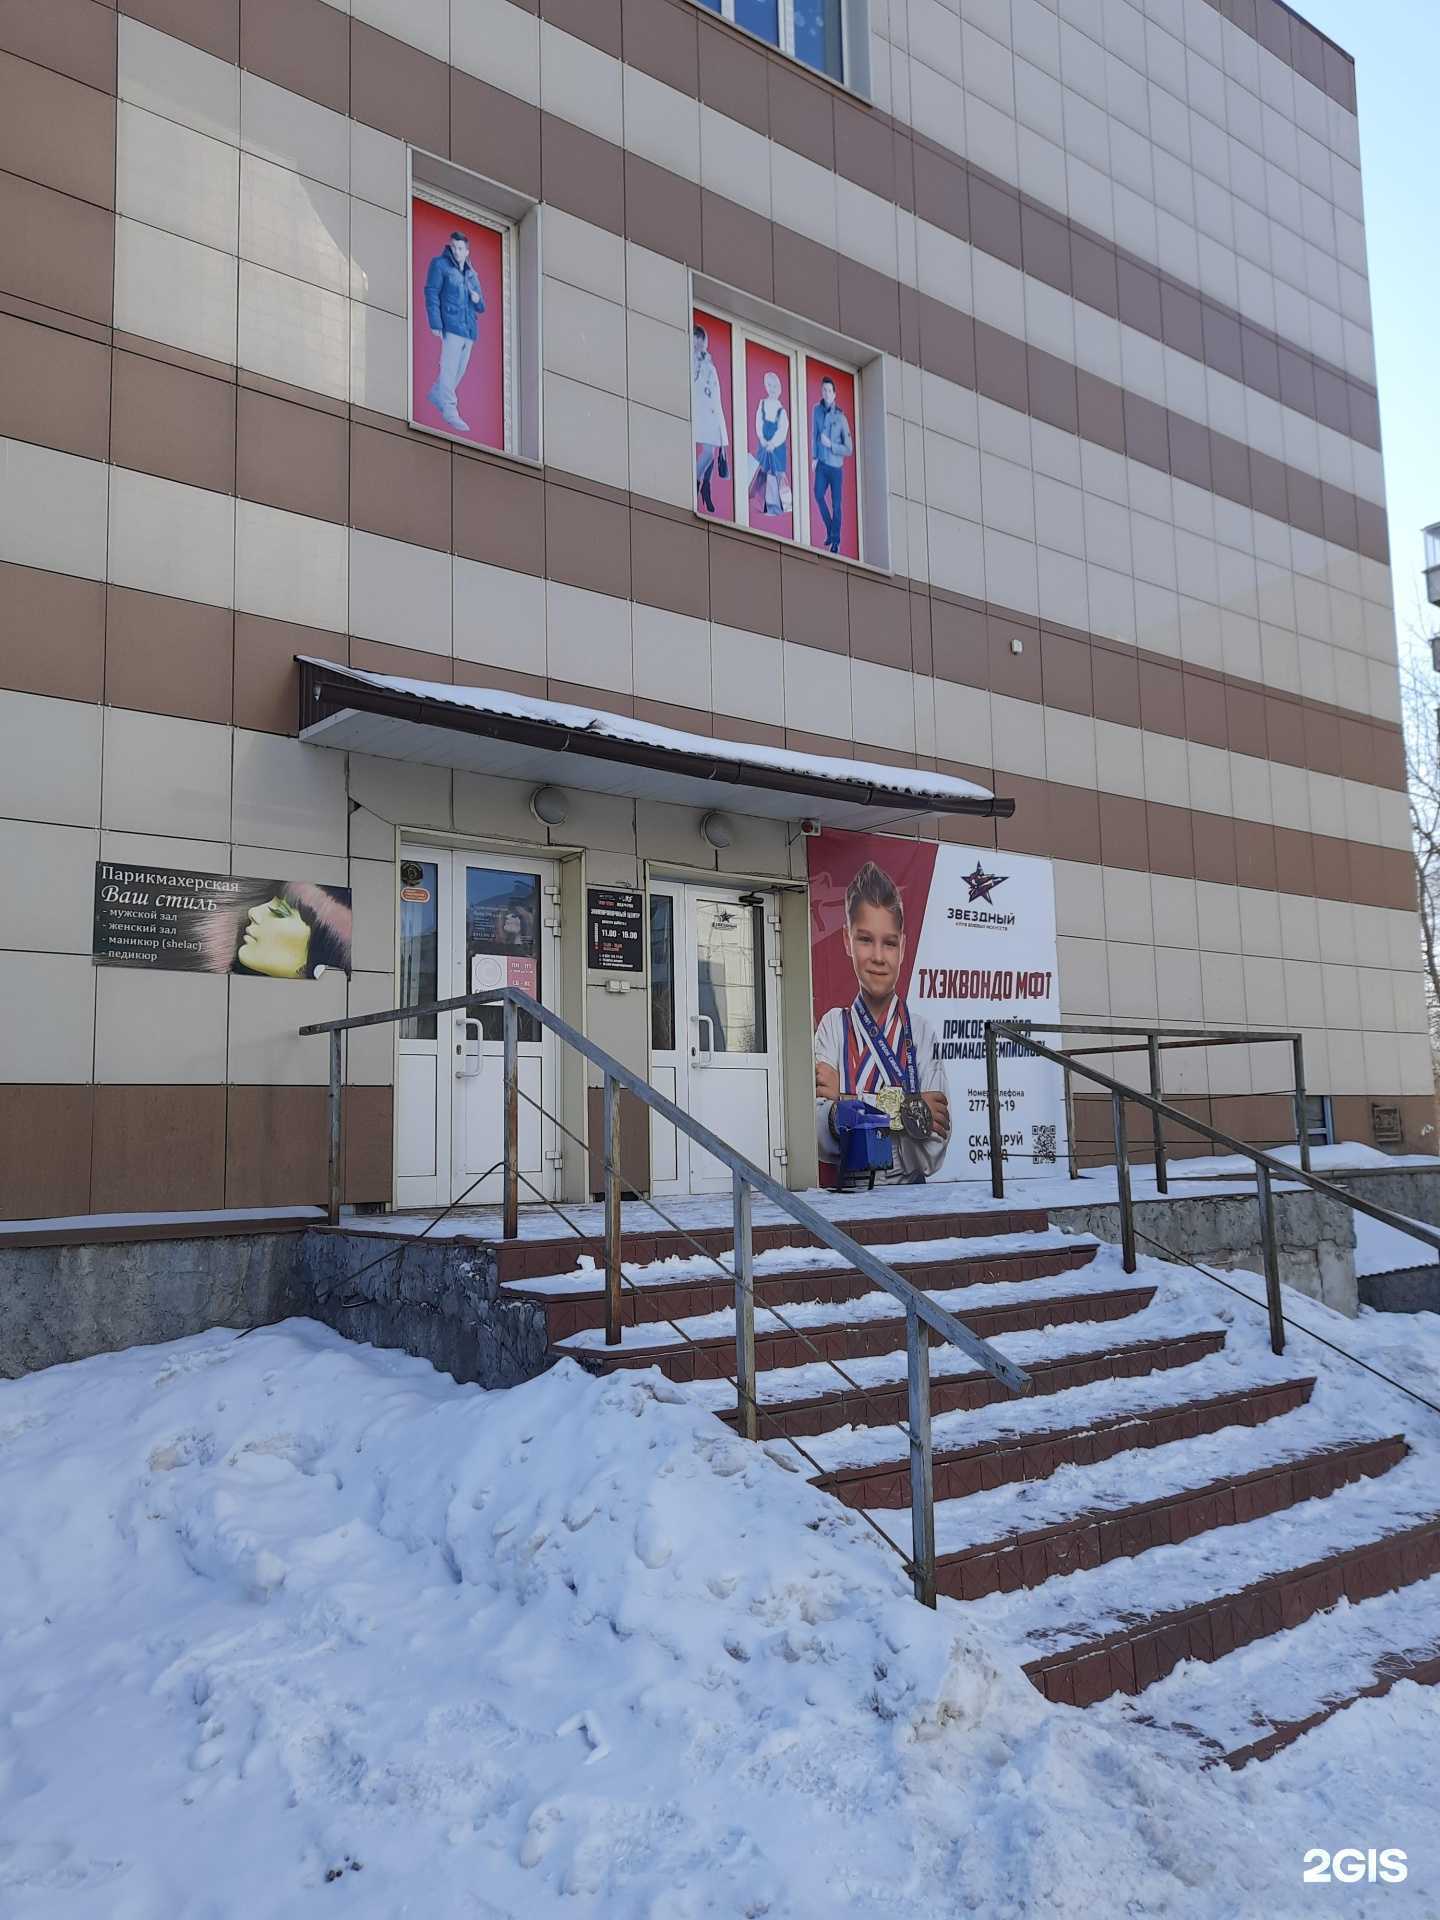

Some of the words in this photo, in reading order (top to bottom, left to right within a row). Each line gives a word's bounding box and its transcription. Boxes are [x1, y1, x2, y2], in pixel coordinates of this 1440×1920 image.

[102, 866, 239, 892] Парикмахерская
[101, 885, 149, 905] Ваш
[155, 894, 217, 912] стиль
[110, 909, 157, 920] мужской
[160, 913, 177, 921] зал
[947, 907, 1015, 925] ЗВЕЗДНЫЙ
[108, 922, 156, 934] женский
[160, 927, 177, 935] зал
[109, 936, 160, 949] маникюр
[162, 938, 202, 951] (shelac)
[109, 950, 158, 962] педикюр
[919, 968, 1013, 1001] ТХЭКВОНДО
[933, 1043, 940, 1060] К
[941, 1042, 986, 1060] КОМАНДЕ
[968, 1099, 1015, 1111] 277--19
[968, 1131, 1024, 1147] СКАРУЙ
[969, 1148, 1008, 1164] QR-КД
